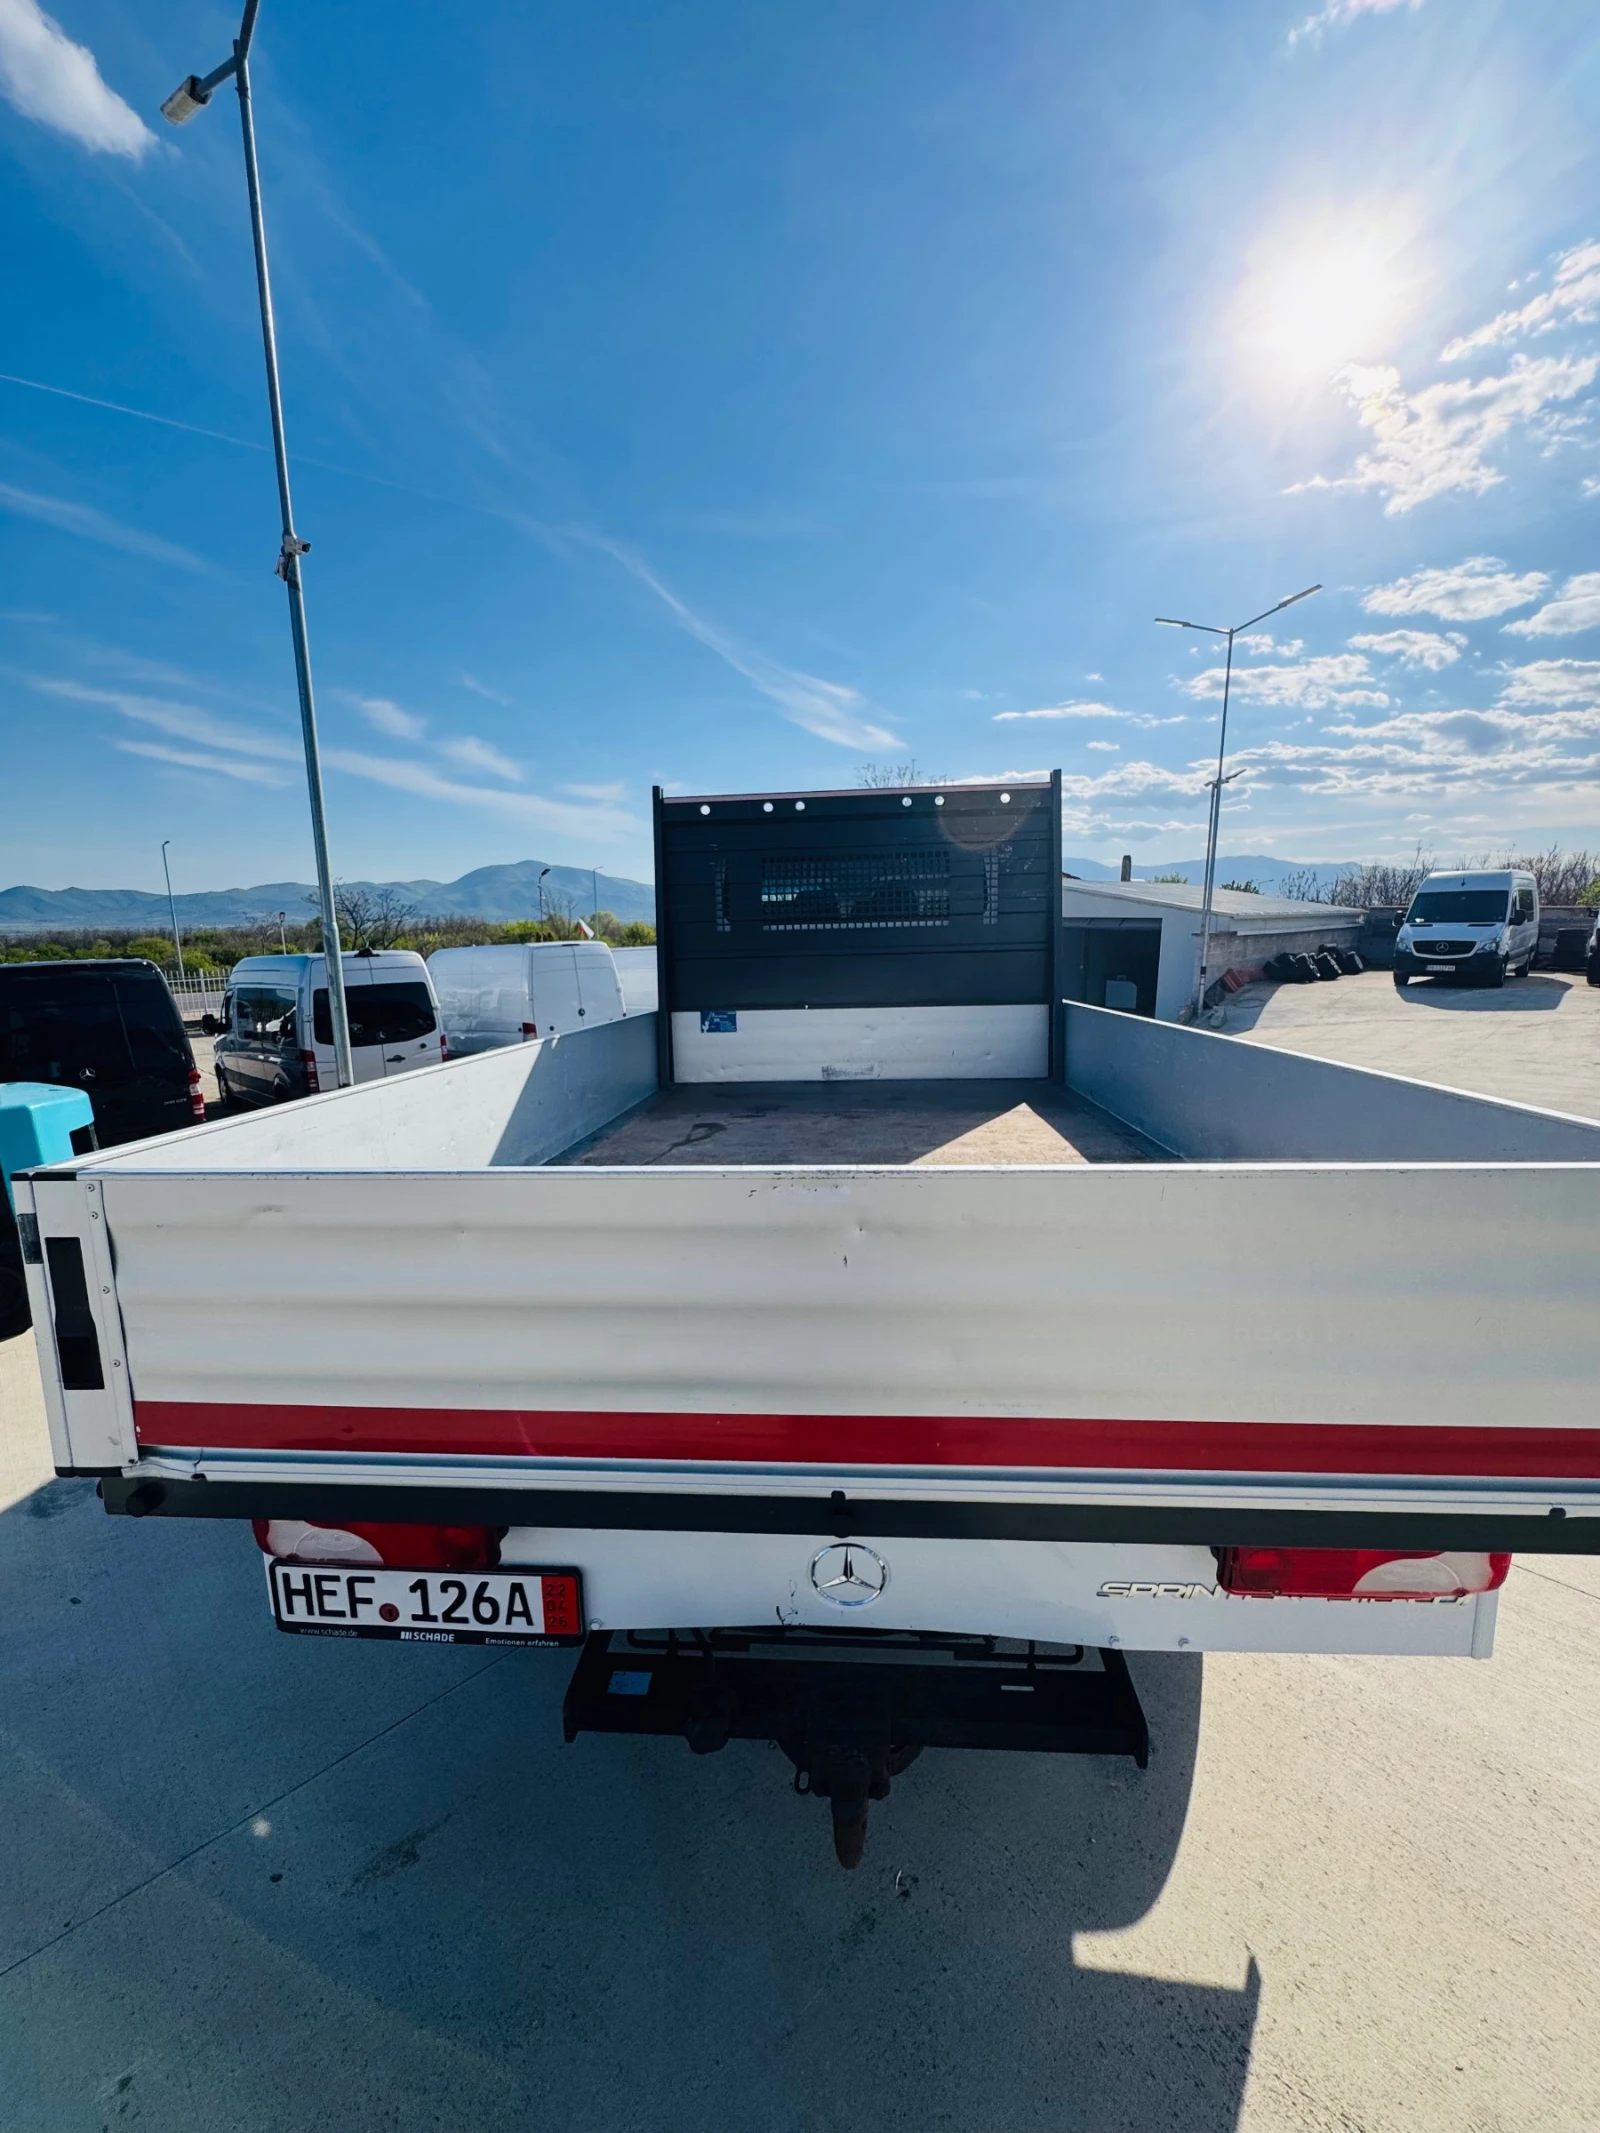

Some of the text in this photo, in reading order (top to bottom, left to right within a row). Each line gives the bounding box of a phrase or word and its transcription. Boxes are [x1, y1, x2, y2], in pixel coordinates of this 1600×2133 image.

[545, 1583, 566, 1597] 22
[281, 1573, 534, 1626] HEF 126A
[547, 1615, 568, 1628] 26
[413, 1631, 455, 1642] SCHADE
[485, 1638, 525, 1646] Emotionen
